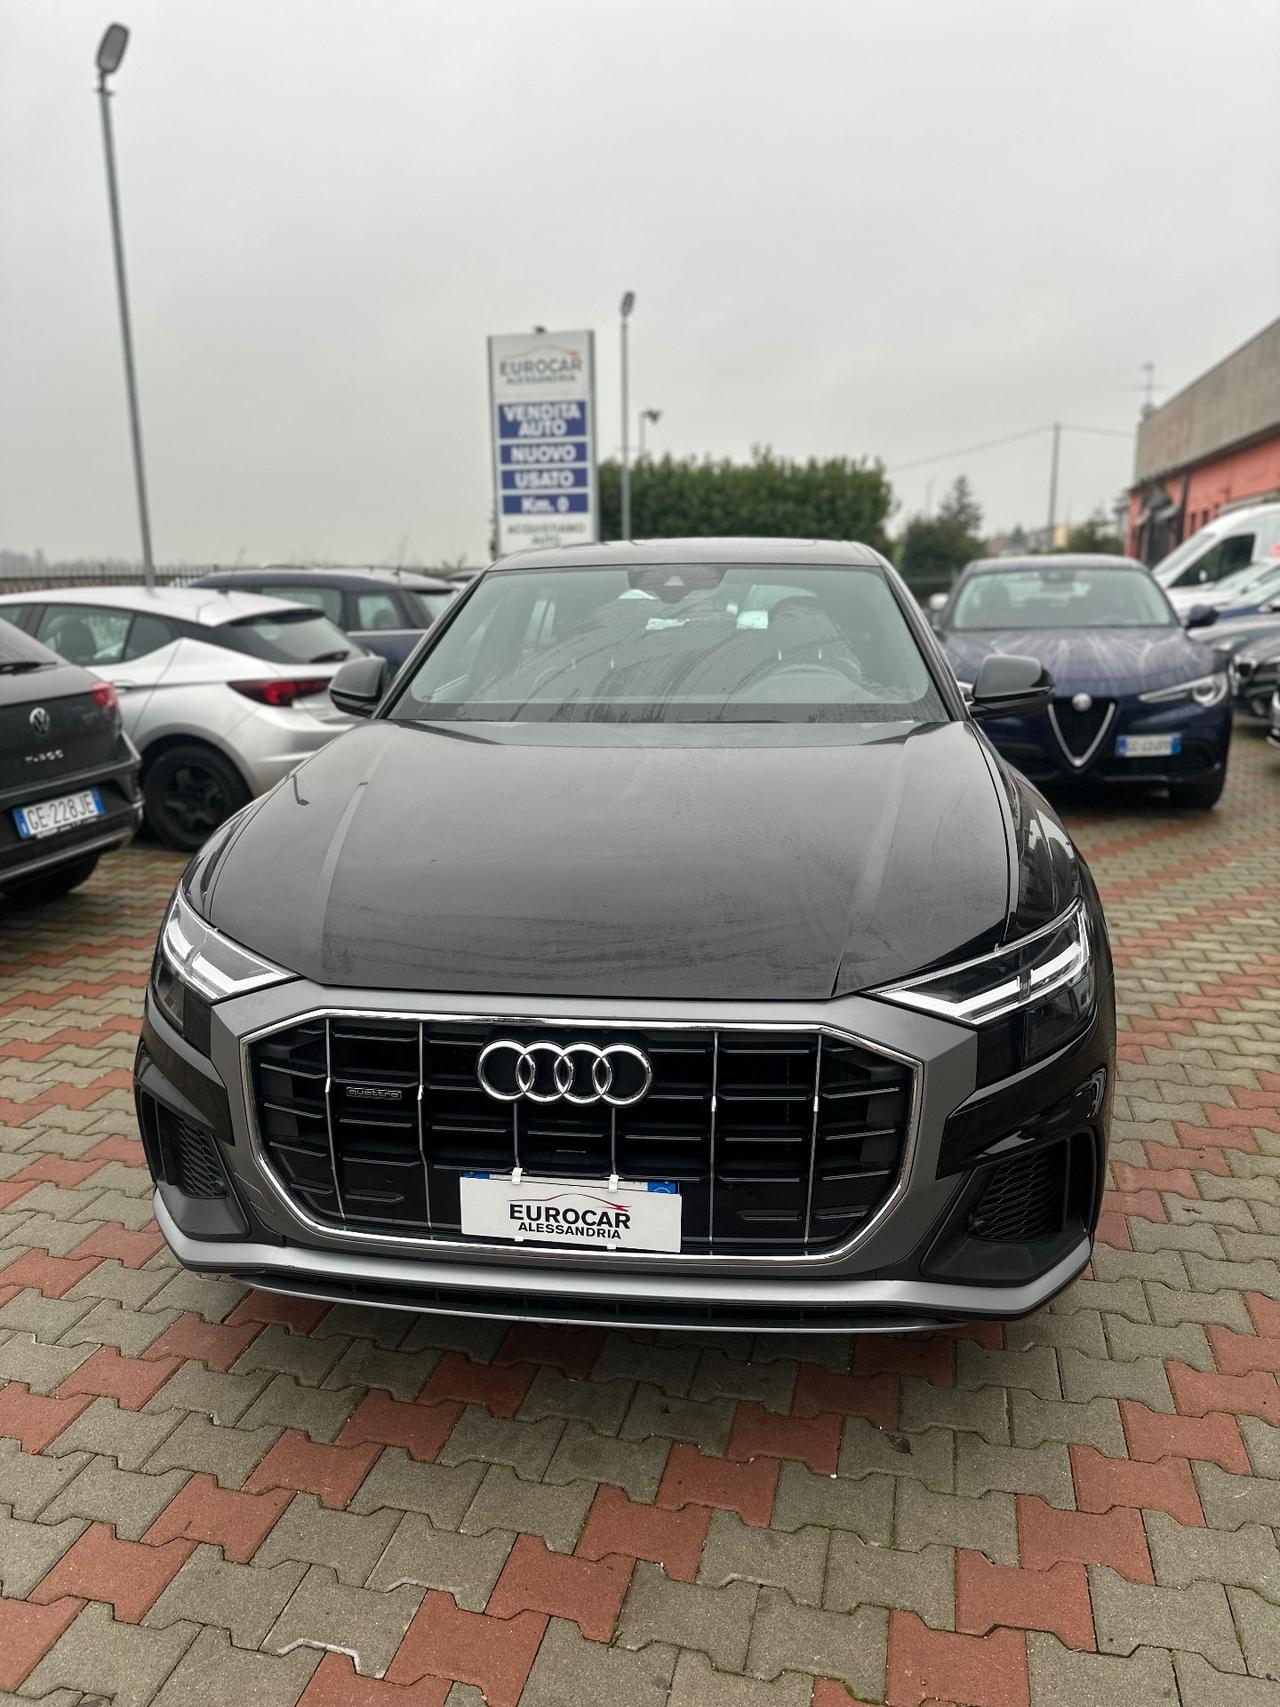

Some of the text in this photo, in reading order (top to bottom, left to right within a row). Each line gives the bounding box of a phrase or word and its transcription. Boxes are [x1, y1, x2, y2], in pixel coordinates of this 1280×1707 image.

[500, 357, 583, 376] EUROCAR
[503, 402, 582, 422] VENDITA
[518, 420, 567, 437] AUTO
[511, 444, 577, 463] NUOVO
[514, 469, 575, 489] USATO
[521, 496, 569, 513] Km. 0
[348, 1089, 399, 1098] quattro
[509, 1203, 631, 1230] EUROCAR
[517, 1221, 622, 1240] ALESSANDRIA
